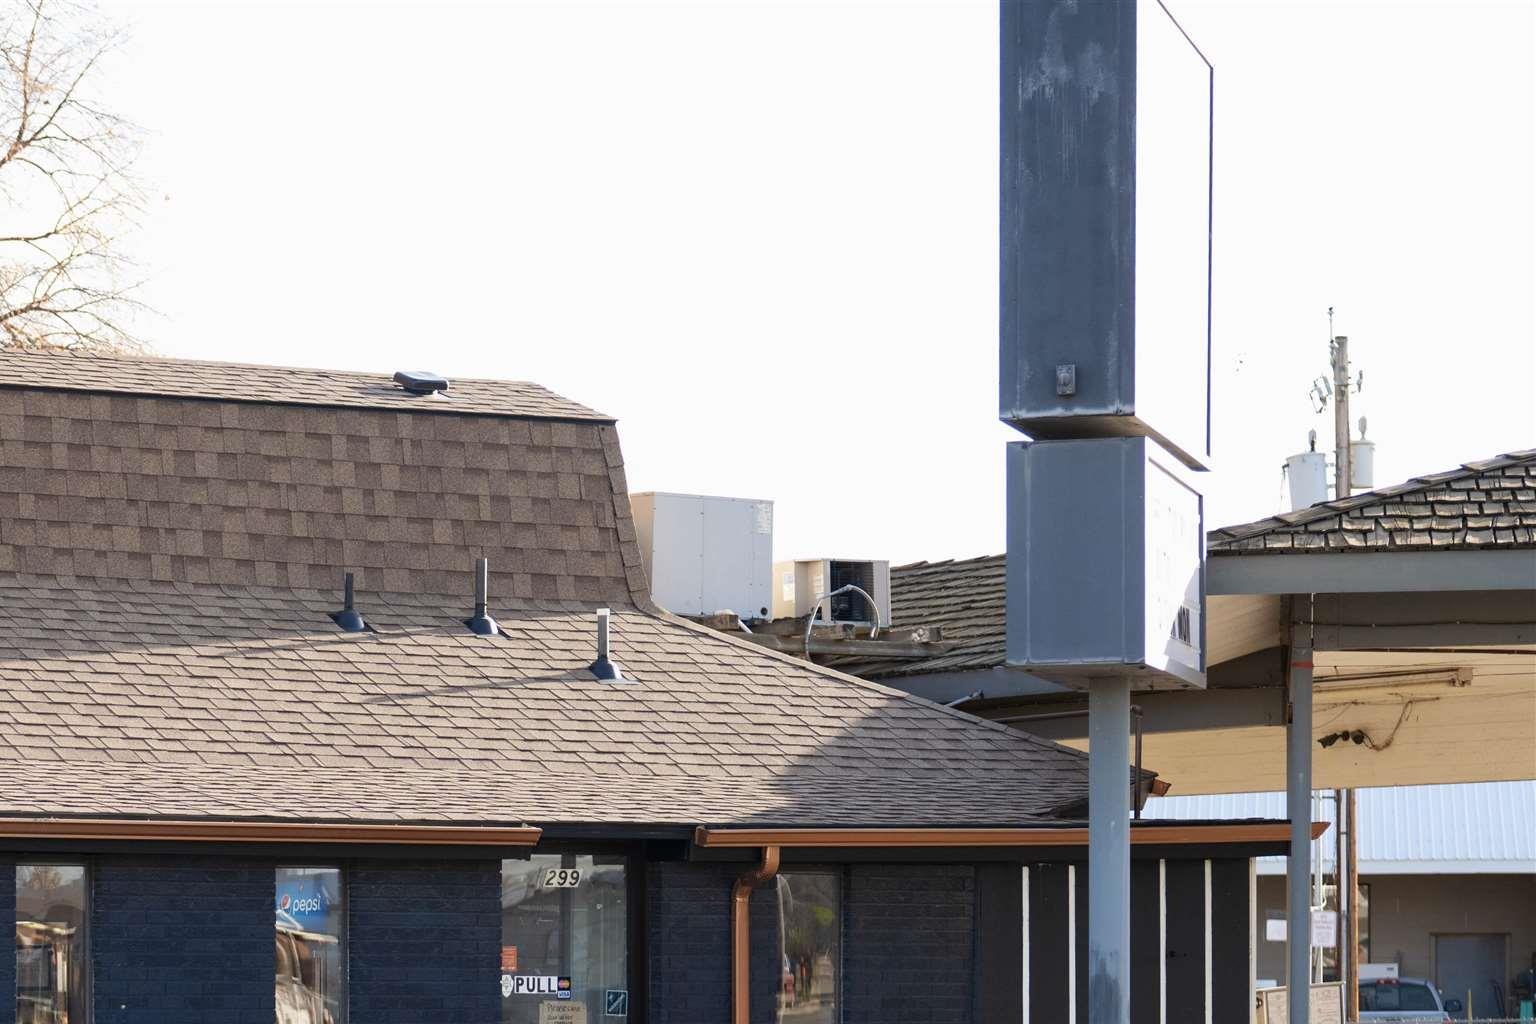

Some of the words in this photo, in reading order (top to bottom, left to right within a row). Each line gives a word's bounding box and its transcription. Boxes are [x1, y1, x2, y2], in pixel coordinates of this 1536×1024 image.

[545, 870, 580, 886] 299
[292, 895, 321, 915] pepsi
[515, 977, 557, 993] PULL
